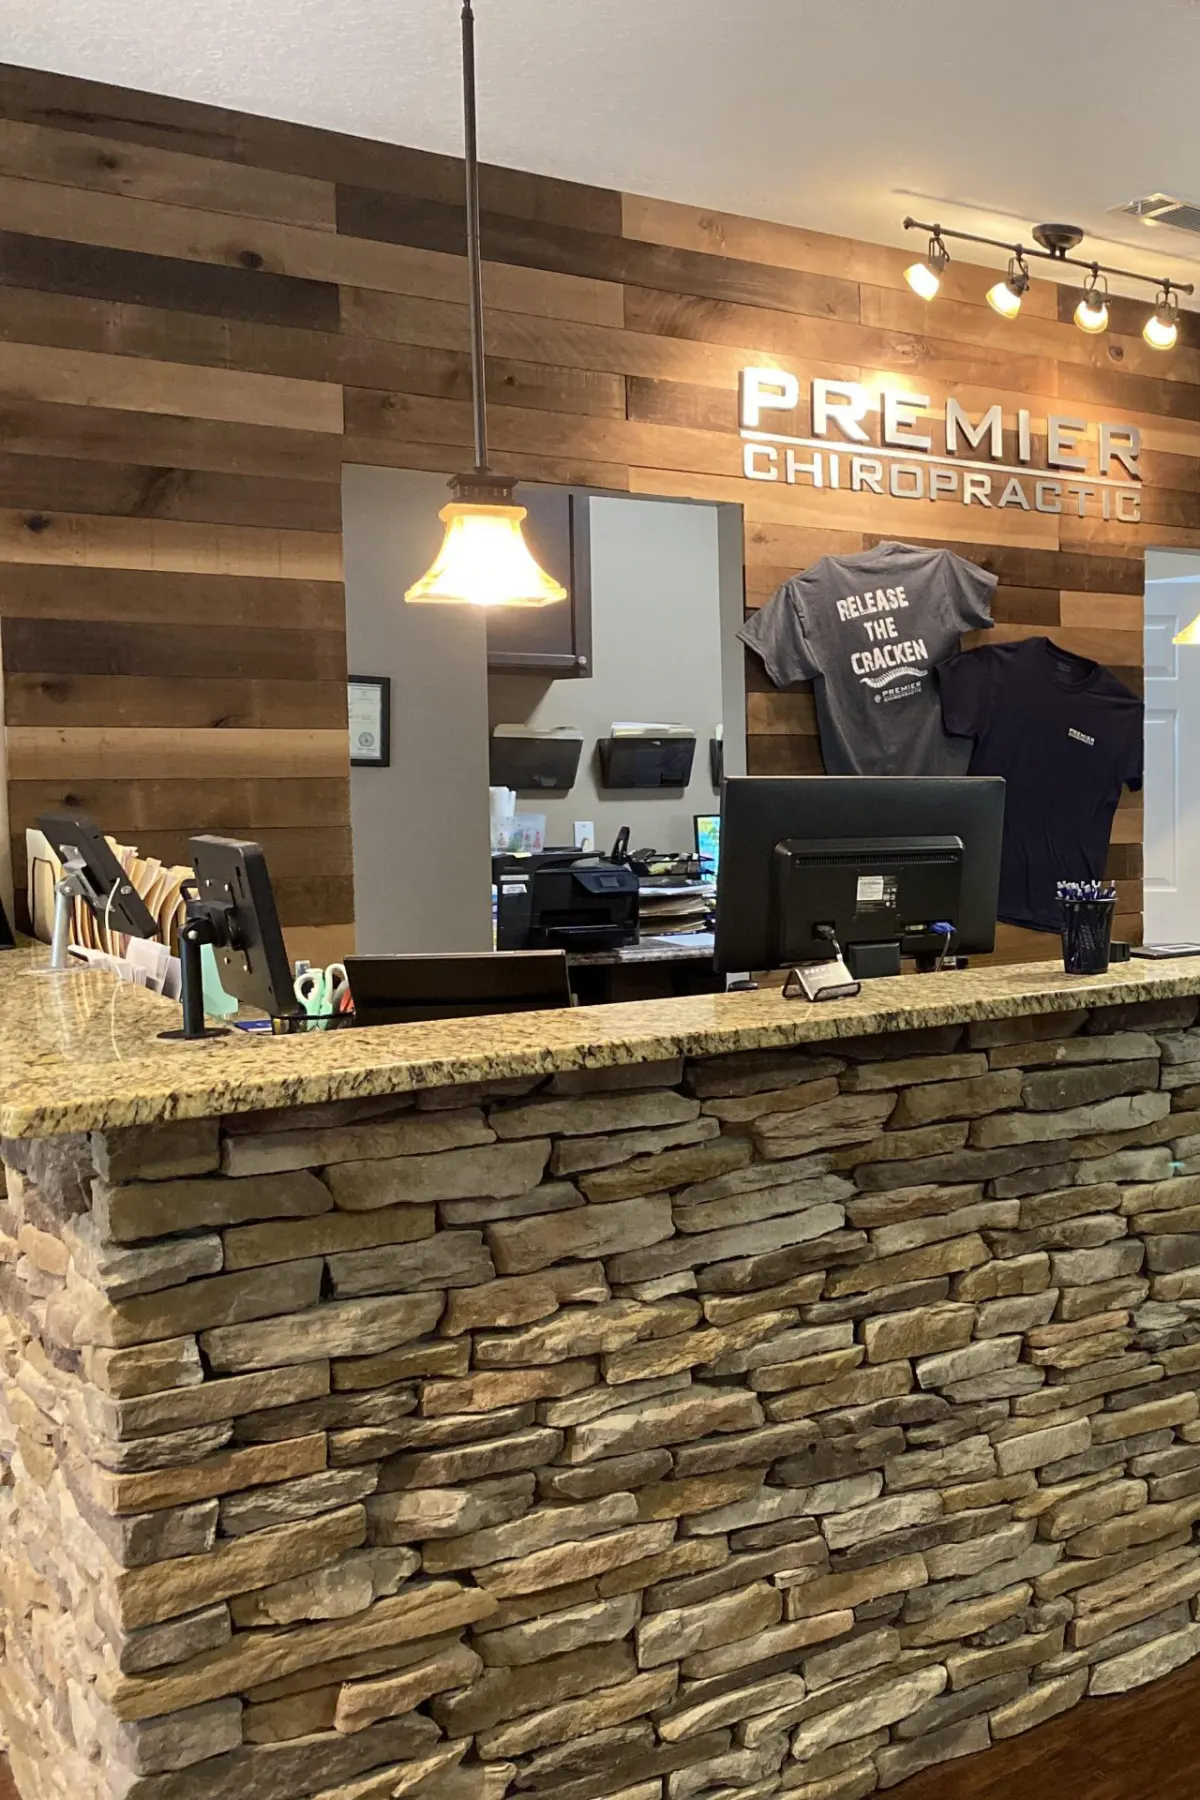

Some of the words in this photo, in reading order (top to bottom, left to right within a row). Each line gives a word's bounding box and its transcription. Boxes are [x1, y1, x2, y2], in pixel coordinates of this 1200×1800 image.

[740, 367, 1142, 479] PREMIER
[743, 443, 1141, 523] CHIROPRACTIC
[836, 586, 909, 622] RELEASE
[863, 617, 898, 641] THE
[850, 638, 928, 674] CRACKEN
[882, 681, 921, 697] PREMIER
